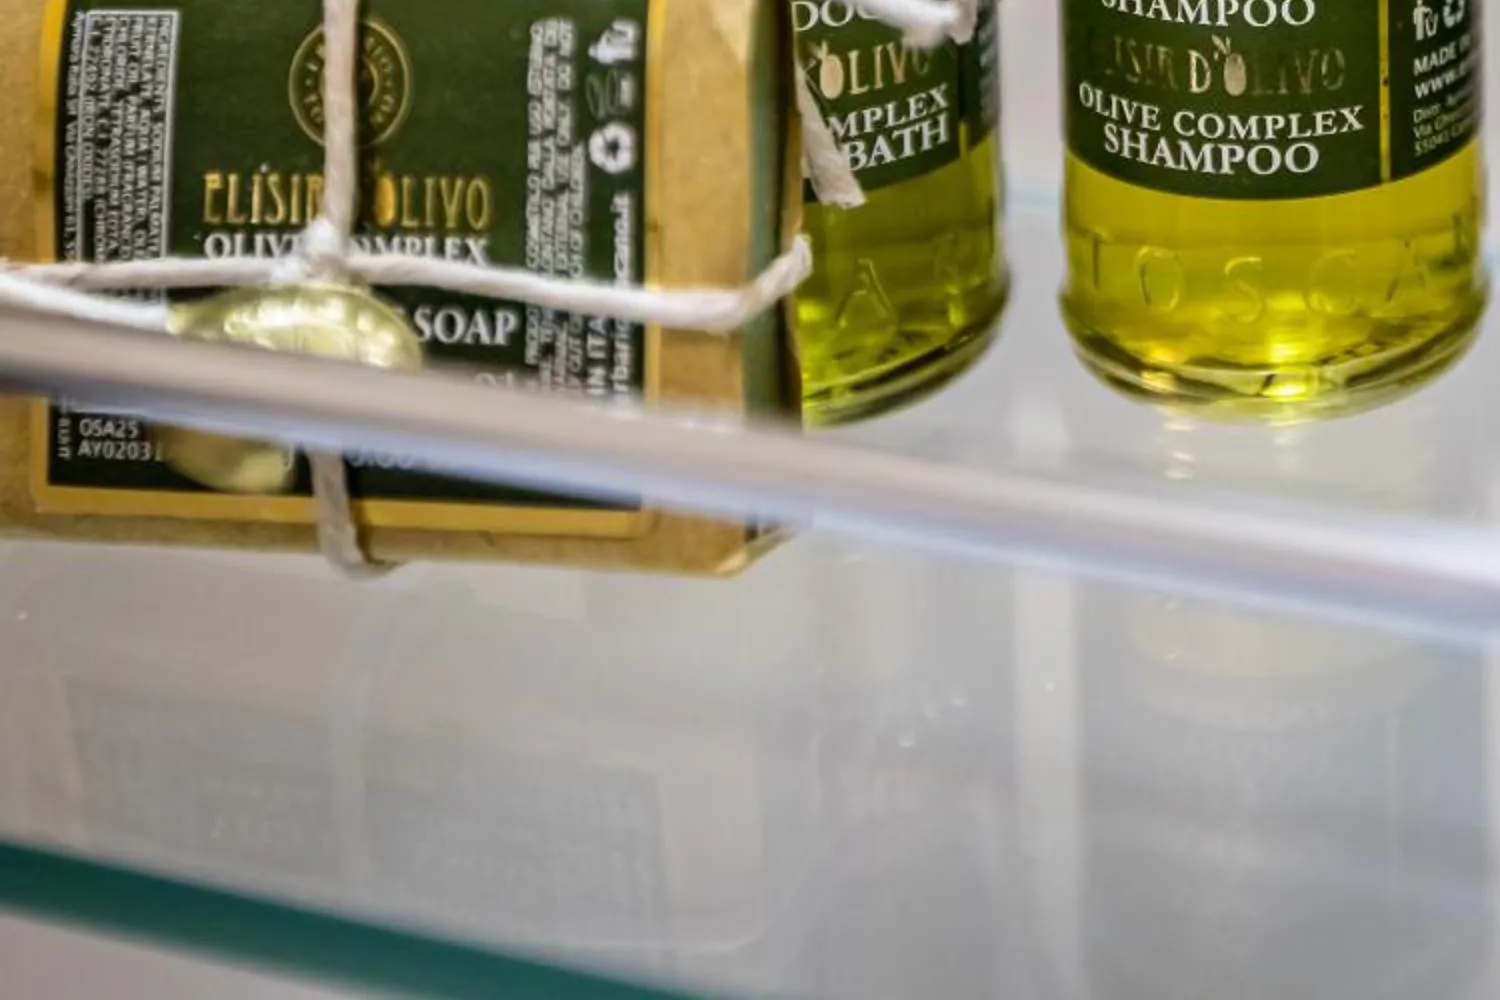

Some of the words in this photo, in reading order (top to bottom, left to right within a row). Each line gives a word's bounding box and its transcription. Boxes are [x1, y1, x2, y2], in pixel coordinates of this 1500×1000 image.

[1413, 41, 1457, 77] MADE
[828, 83, 949, 140] MPLEX
[1078, 80, 1162, 131] OLIVE
[1172, 105, 1365, 140] COMPLEX
[839, 112, 950, 171] BATH
[1103, 122, 1320, 176] SHAMPOO
[413, 304, 517, 347] SOAP
